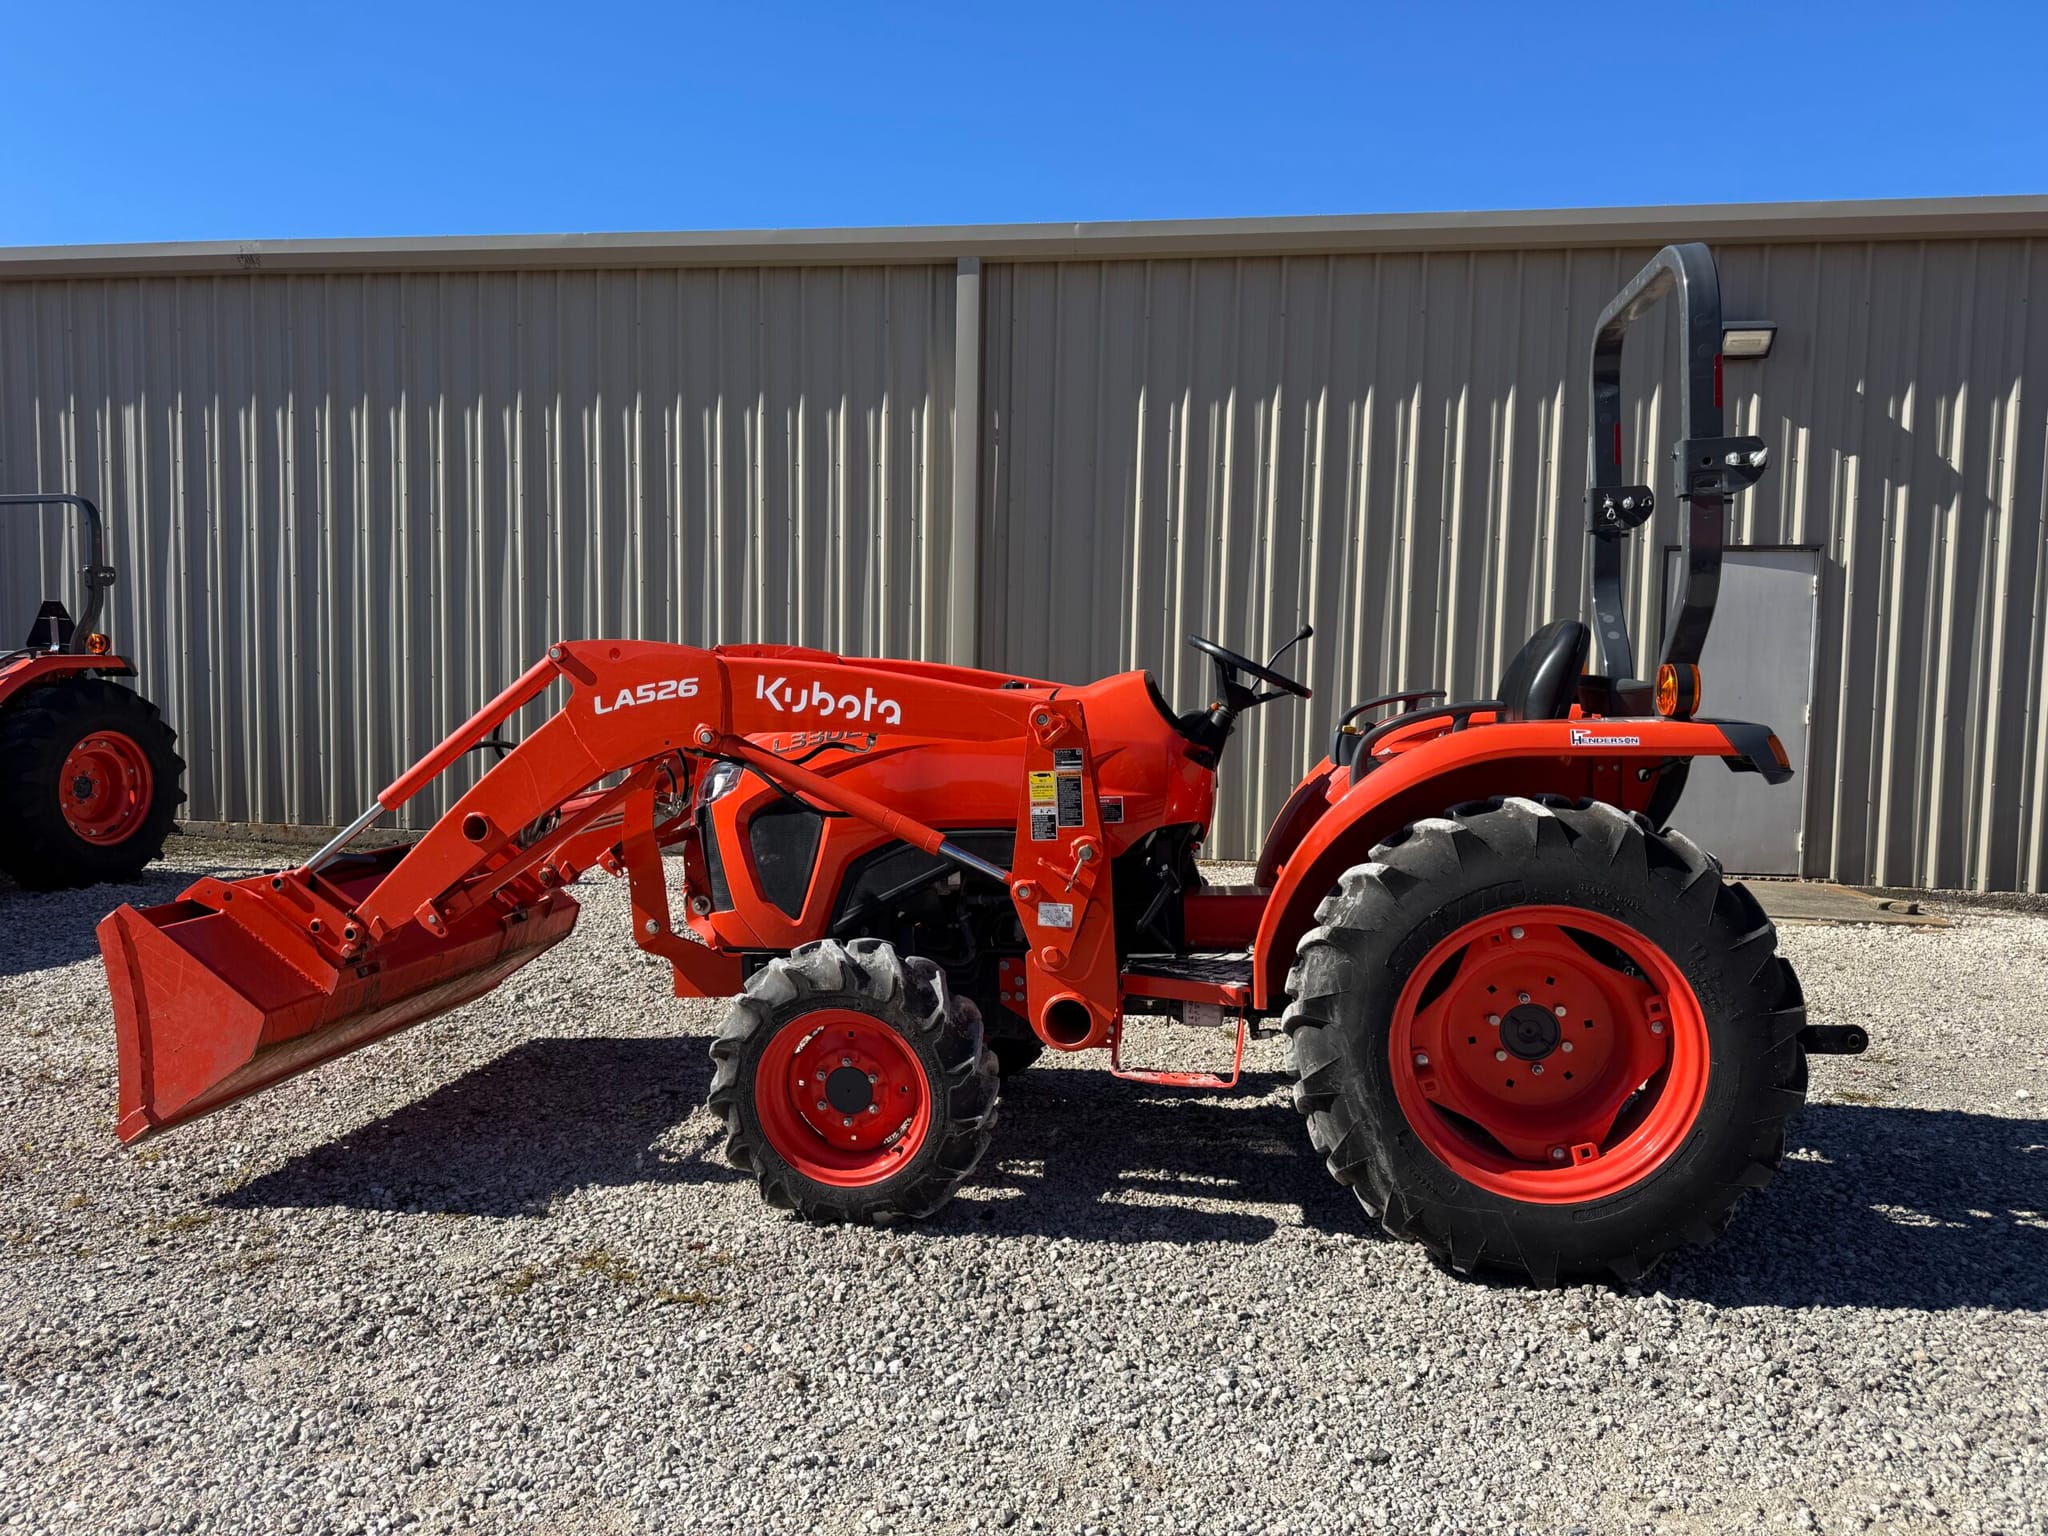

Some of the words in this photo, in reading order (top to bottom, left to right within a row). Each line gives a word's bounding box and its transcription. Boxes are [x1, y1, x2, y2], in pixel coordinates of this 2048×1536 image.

[593, 677, 699, 715] LA526
[755, 674, 902, 725] Kubota
[1571, 729, 1639, 745] HENDERSON
